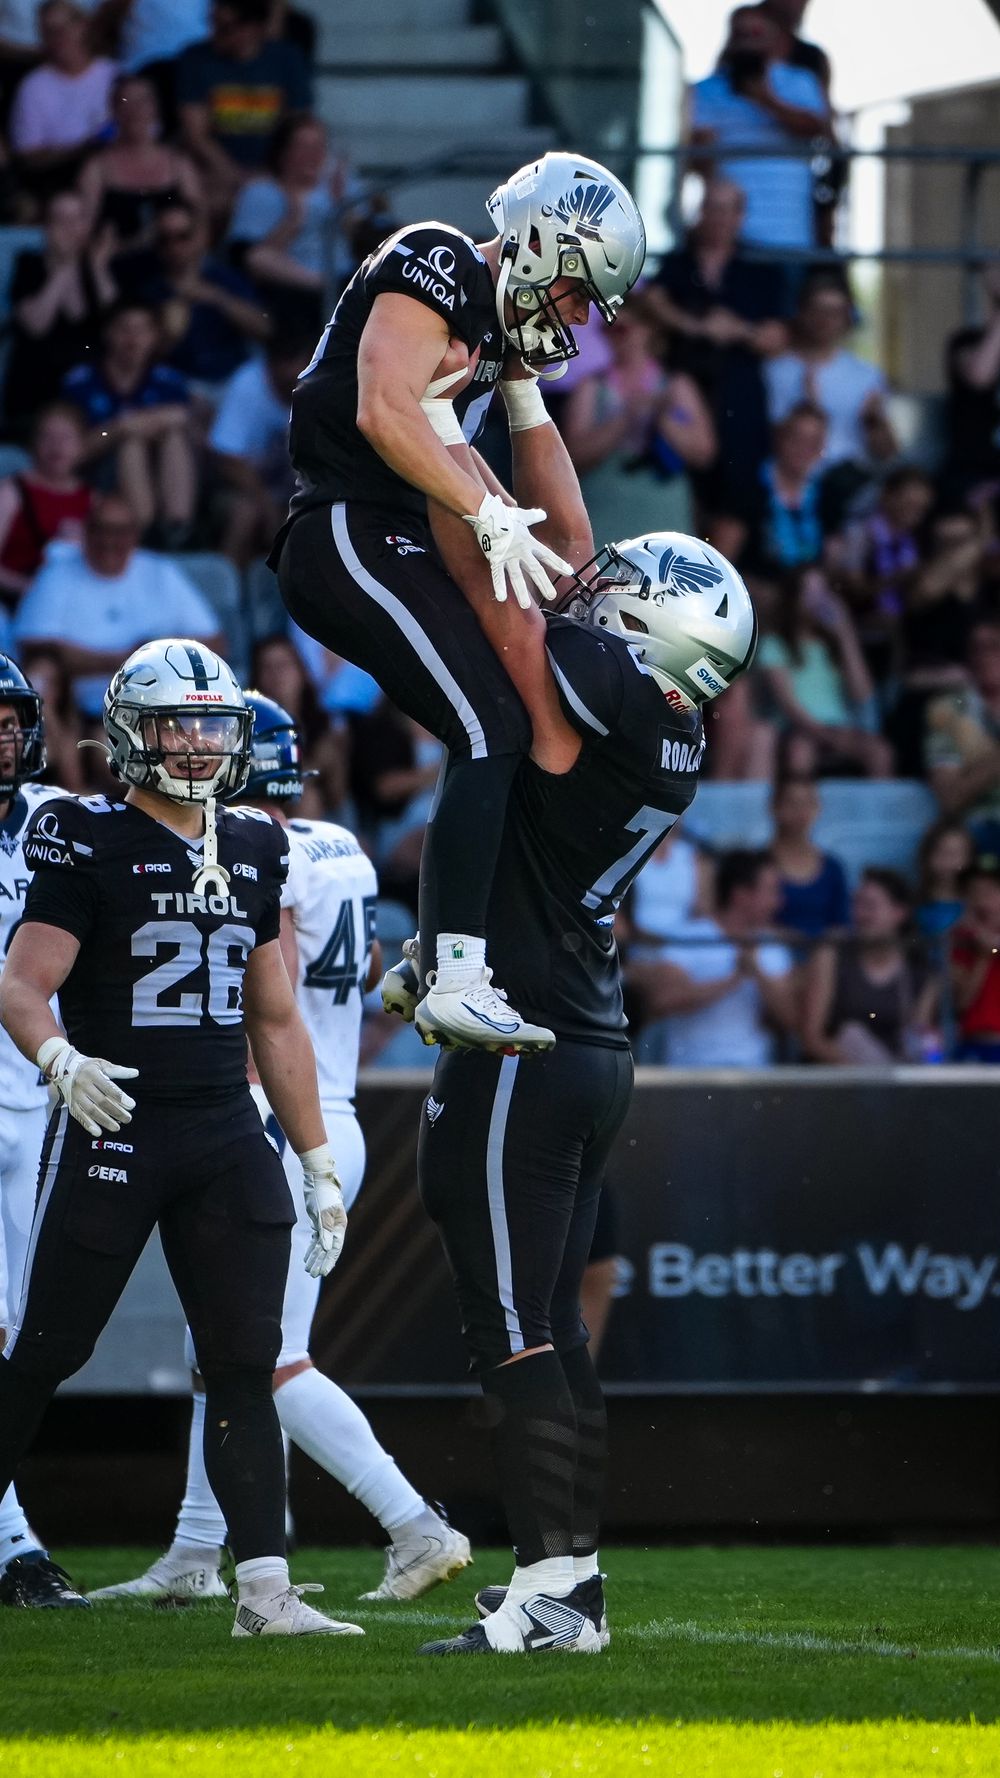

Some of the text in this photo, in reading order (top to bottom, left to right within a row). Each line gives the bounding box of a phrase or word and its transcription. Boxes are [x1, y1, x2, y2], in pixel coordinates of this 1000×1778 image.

[402, 261, 455, 311] UNIQA
[185, 694, 224, 702] FORELLE
[25, 843, 75, 867] UNIQA
[241, 864, 258, 882] EFA
[150, 892, 248, 919] TIROL
[131, 920, 257, 1027] 26
[98, 1165, 128, 1184] EFA
[650, 1242, 845, 1297] Better
